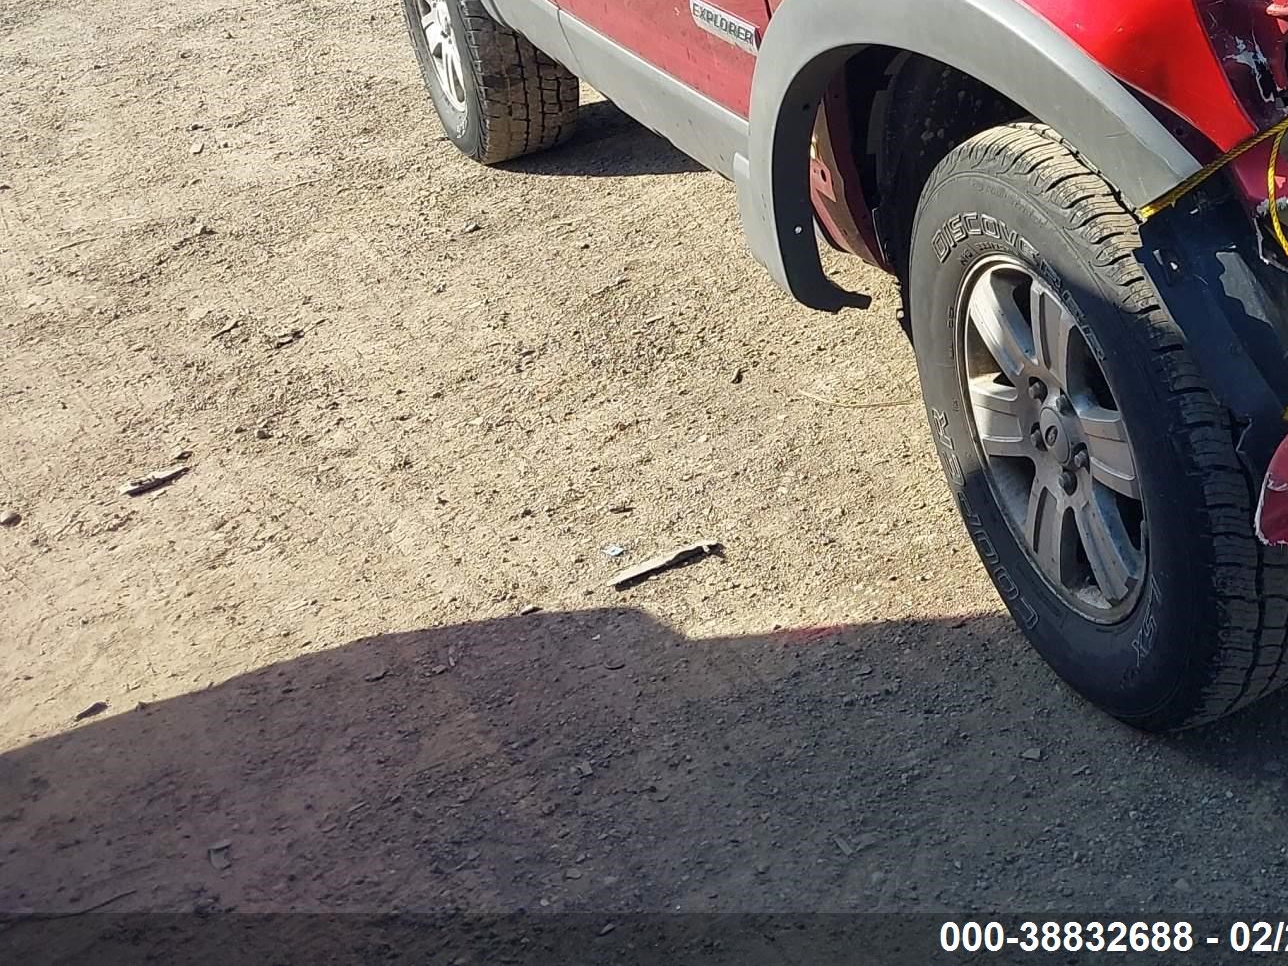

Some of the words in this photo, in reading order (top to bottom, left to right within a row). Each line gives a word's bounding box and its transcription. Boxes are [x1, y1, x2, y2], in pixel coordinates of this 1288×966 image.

[692, 3, 754, 45] EXPLORER
[931, 211, 1107, 362] DISCOVERER
[932, 408, 1040, 631] COOPER
